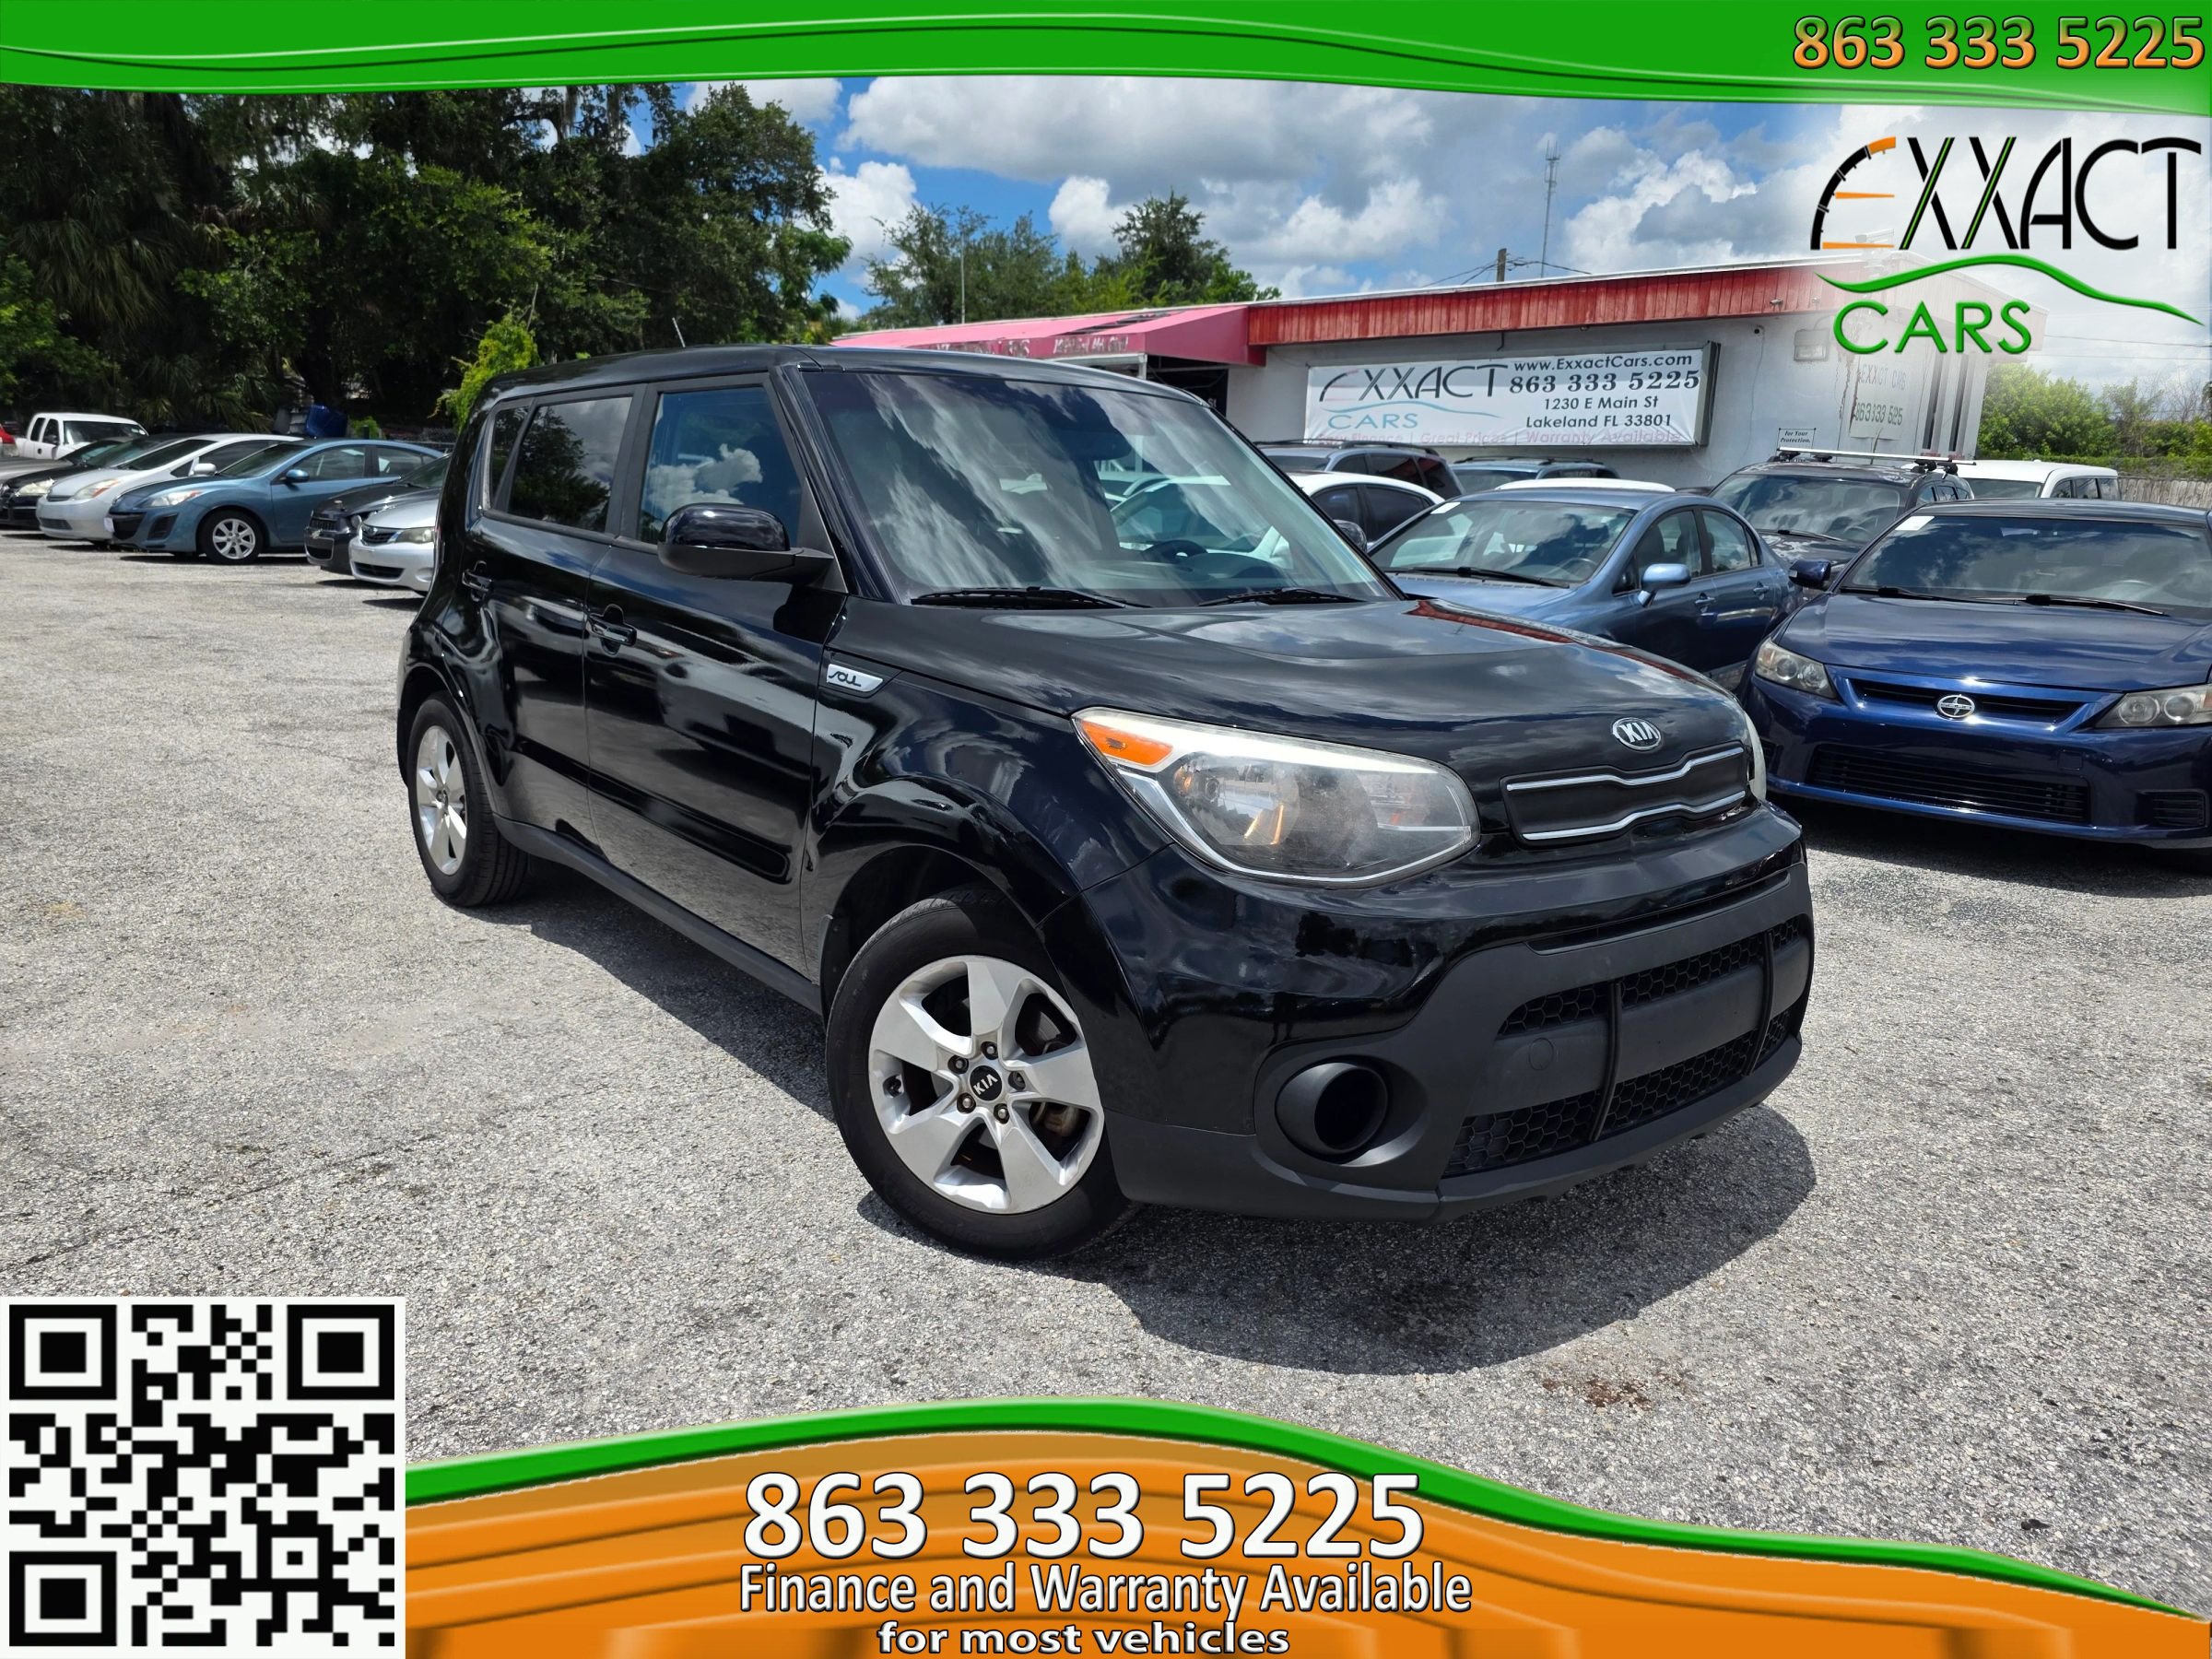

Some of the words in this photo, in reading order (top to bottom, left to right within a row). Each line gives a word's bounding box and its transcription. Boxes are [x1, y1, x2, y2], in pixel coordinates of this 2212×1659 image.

[1514, 355, 1692, 371] www.ExxactCars.com
[1319, 364, 1509, 402] EXXACT
[1509, 374, 1556, 394] 863
[1568, 372, 1617, 392] 333
[1629, 370, 1700, 390] 5225
[1545, 398, 1579, 410] 1230
[1584, 397, 1592, 409] E
[1598, 396, 1638, 409] Main
[1644, 395, 1658, 408] St
[1328, 413, 1418, 429] CARS
[1526, 416, 1597, 429] Lakeland
[1604, 415, 1618, 427] FL
[1624, 414, 1671, 427] 33801
[1420, 432, 1460, 444] Great
[1525, 431, 1592, 445] Warranty
[1602, 429, 1680, 443] Available
[1618, 722, 1659, 743] KIA
[972, 1074, 998, 1095] KIA
